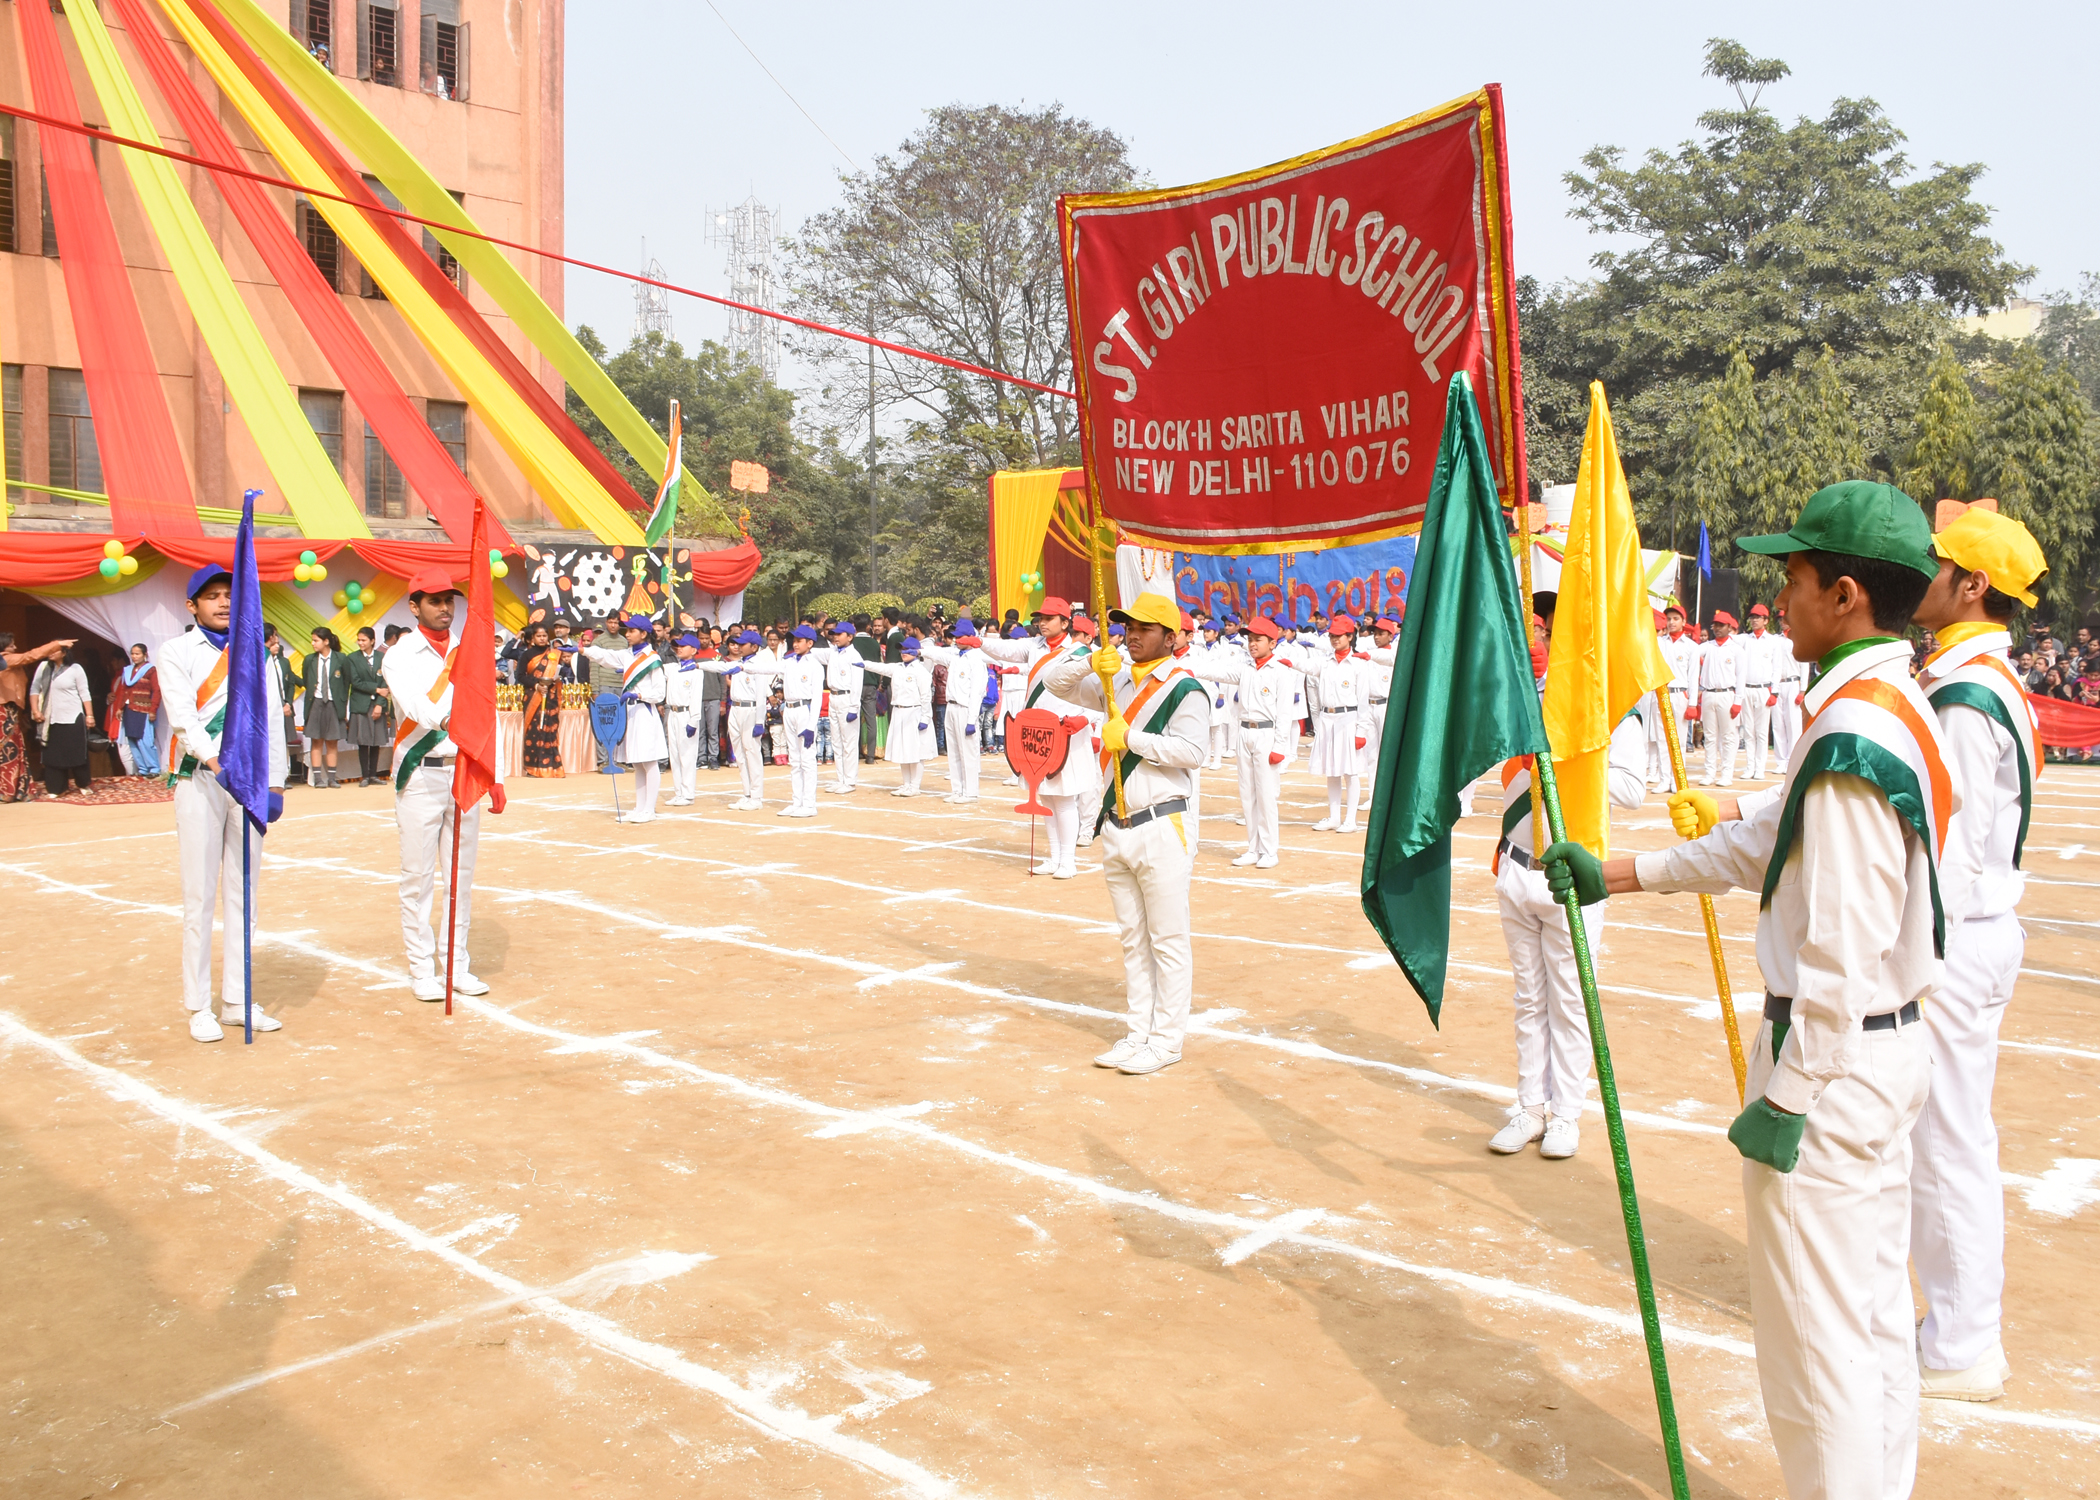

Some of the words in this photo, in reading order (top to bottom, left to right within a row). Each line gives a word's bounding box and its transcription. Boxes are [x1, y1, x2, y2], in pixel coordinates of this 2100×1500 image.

[1093, 307, 1158, 403] ST.
[1137, 230, 1212, 340] GIRI
[1210, 193, 1350, 289] PUBLIC
[1338, 210, 1474, 385] SCHOOL
[1113, 417, 1212, 452] BLOCK-H
[1221, 409, 1305, 449] SARITA
[1320, 390, 1410, 438] VIHAR
[1115, 456, 1175, 495] NEW
[1175, 565, 1319, 624] Srijan
[1325, 566, 1407, 622] 2018
[1021, 727, 1053, 745] BHAGAT
[1022, 740, 1051, 757] HOUSE
